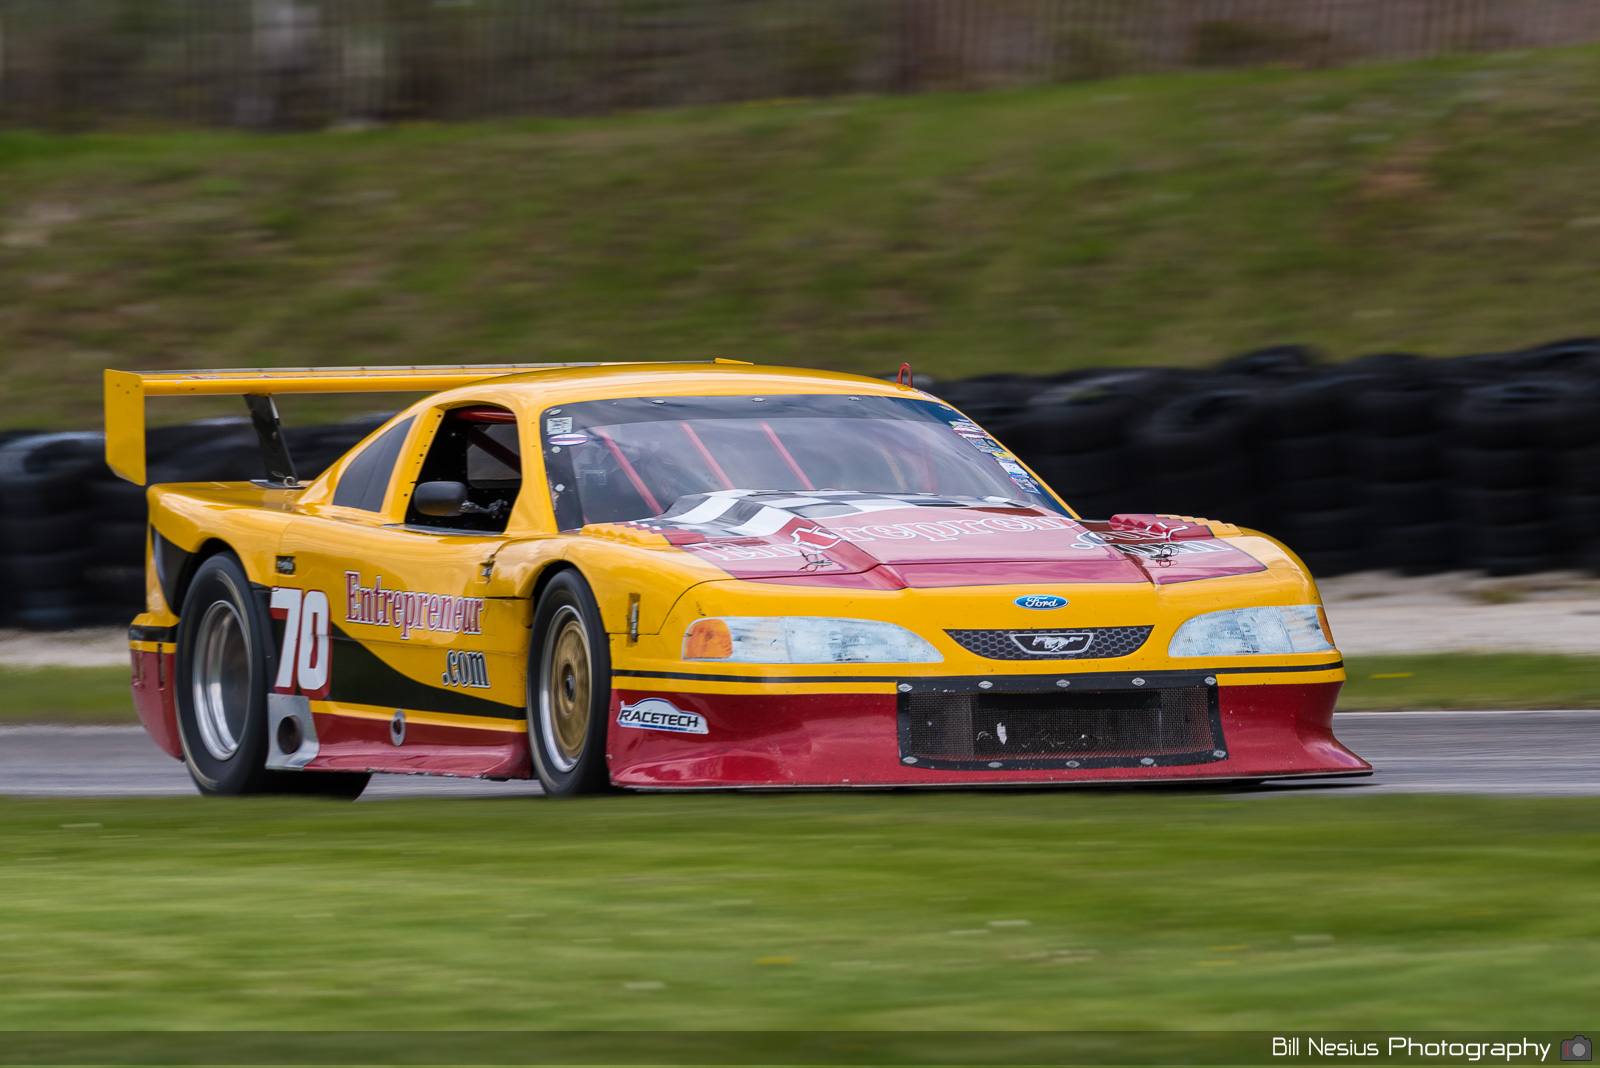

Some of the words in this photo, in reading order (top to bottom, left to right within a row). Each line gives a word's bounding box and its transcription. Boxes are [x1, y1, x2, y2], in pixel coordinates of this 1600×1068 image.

[344, 570, 485, 640] Entrepreneur
[1024, 595, 1060, 609] Ford
[269, 585, 332, 699] 70
[441, 648, 492, 689] .com
[618, 709, 700, 728] RACETECH
